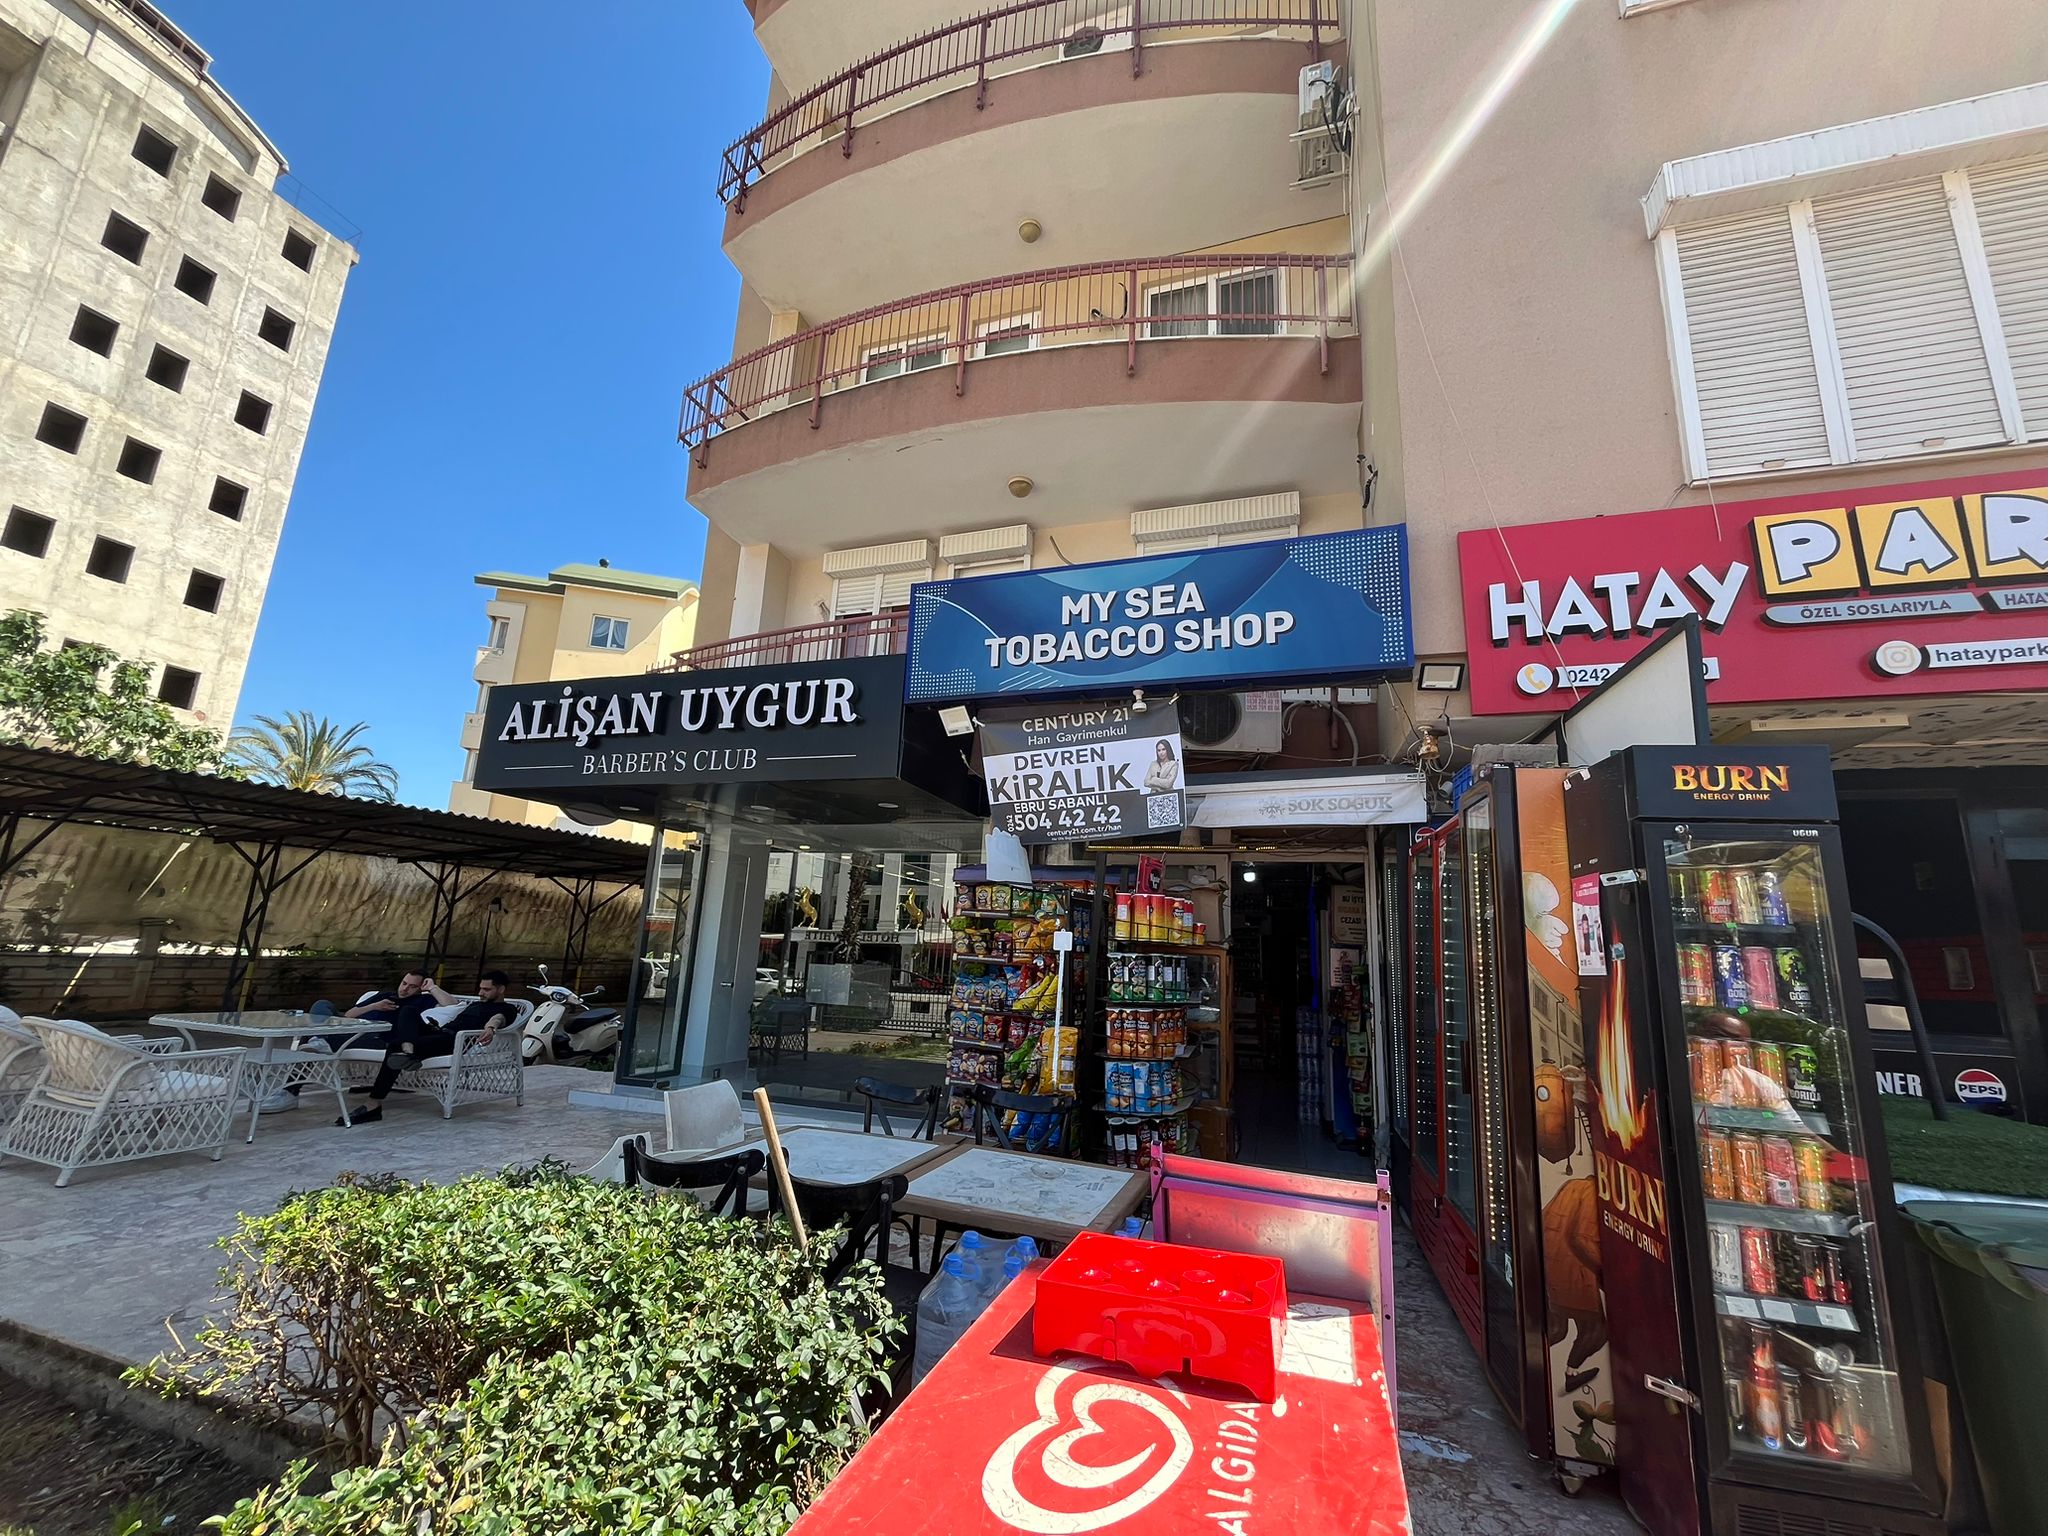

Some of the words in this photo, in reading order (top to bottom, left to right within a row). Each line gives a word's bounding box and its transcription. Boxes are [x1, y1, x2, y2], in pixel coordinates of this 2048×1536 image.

[1061, 590, 1117, 626] MY
[1124, 582, 1206, 620] SEA
[1488, 560, 1749, 641] HATAY
[1800, 605, 1842, 619] ÖZEL
[1847, 599, 1952, 617] SOSLARIYLA
[2004, 592, 2048, 606] HATA
[984, 622, 1165, 668] TOBACCO
[1174, 610, 1295, 653] SHOP
[1568, 668, 1610, 683] 0242
[498, 686, 662, 747] ALİŞAN
[680, 678, 858, 732] UYGUR
[1022, 710, 1107, 733] CENTURY
[1112, 707, 1129, 722] 21
[1028, 735, 1051, 746] Han
[1056, 724, 1127, 743] Gayrimenkul
[581, 750, 687, 776] BARBER'S
[693, 748, 757, 771] CLUB
[1014, 746, 1106, 771] DEVREN
[1671, 764, 1790, 792] BURN
[1014, 800, 1045, 814] EBRU
[1048, 794, 1108, 810] SABANLI
[1693, 793, 1735, 801] ENERGY
[1738, 793, 1771, 801] DRINK
[1014, 813, 1053, 831] 504
[1058, 809, 1086, 827] 42
[1093, 805, 1121, 824] 42
[1046, 824, 1122, 837] century21.com.tr/han
[1958, 1083, 2003, 1096] PEPSI
[1595, 1150, 1667, 1237] BURN
[1604, 1210, 1634, 1242] ENERGY
[1636, 1230, 1665, 1263] DRINK
